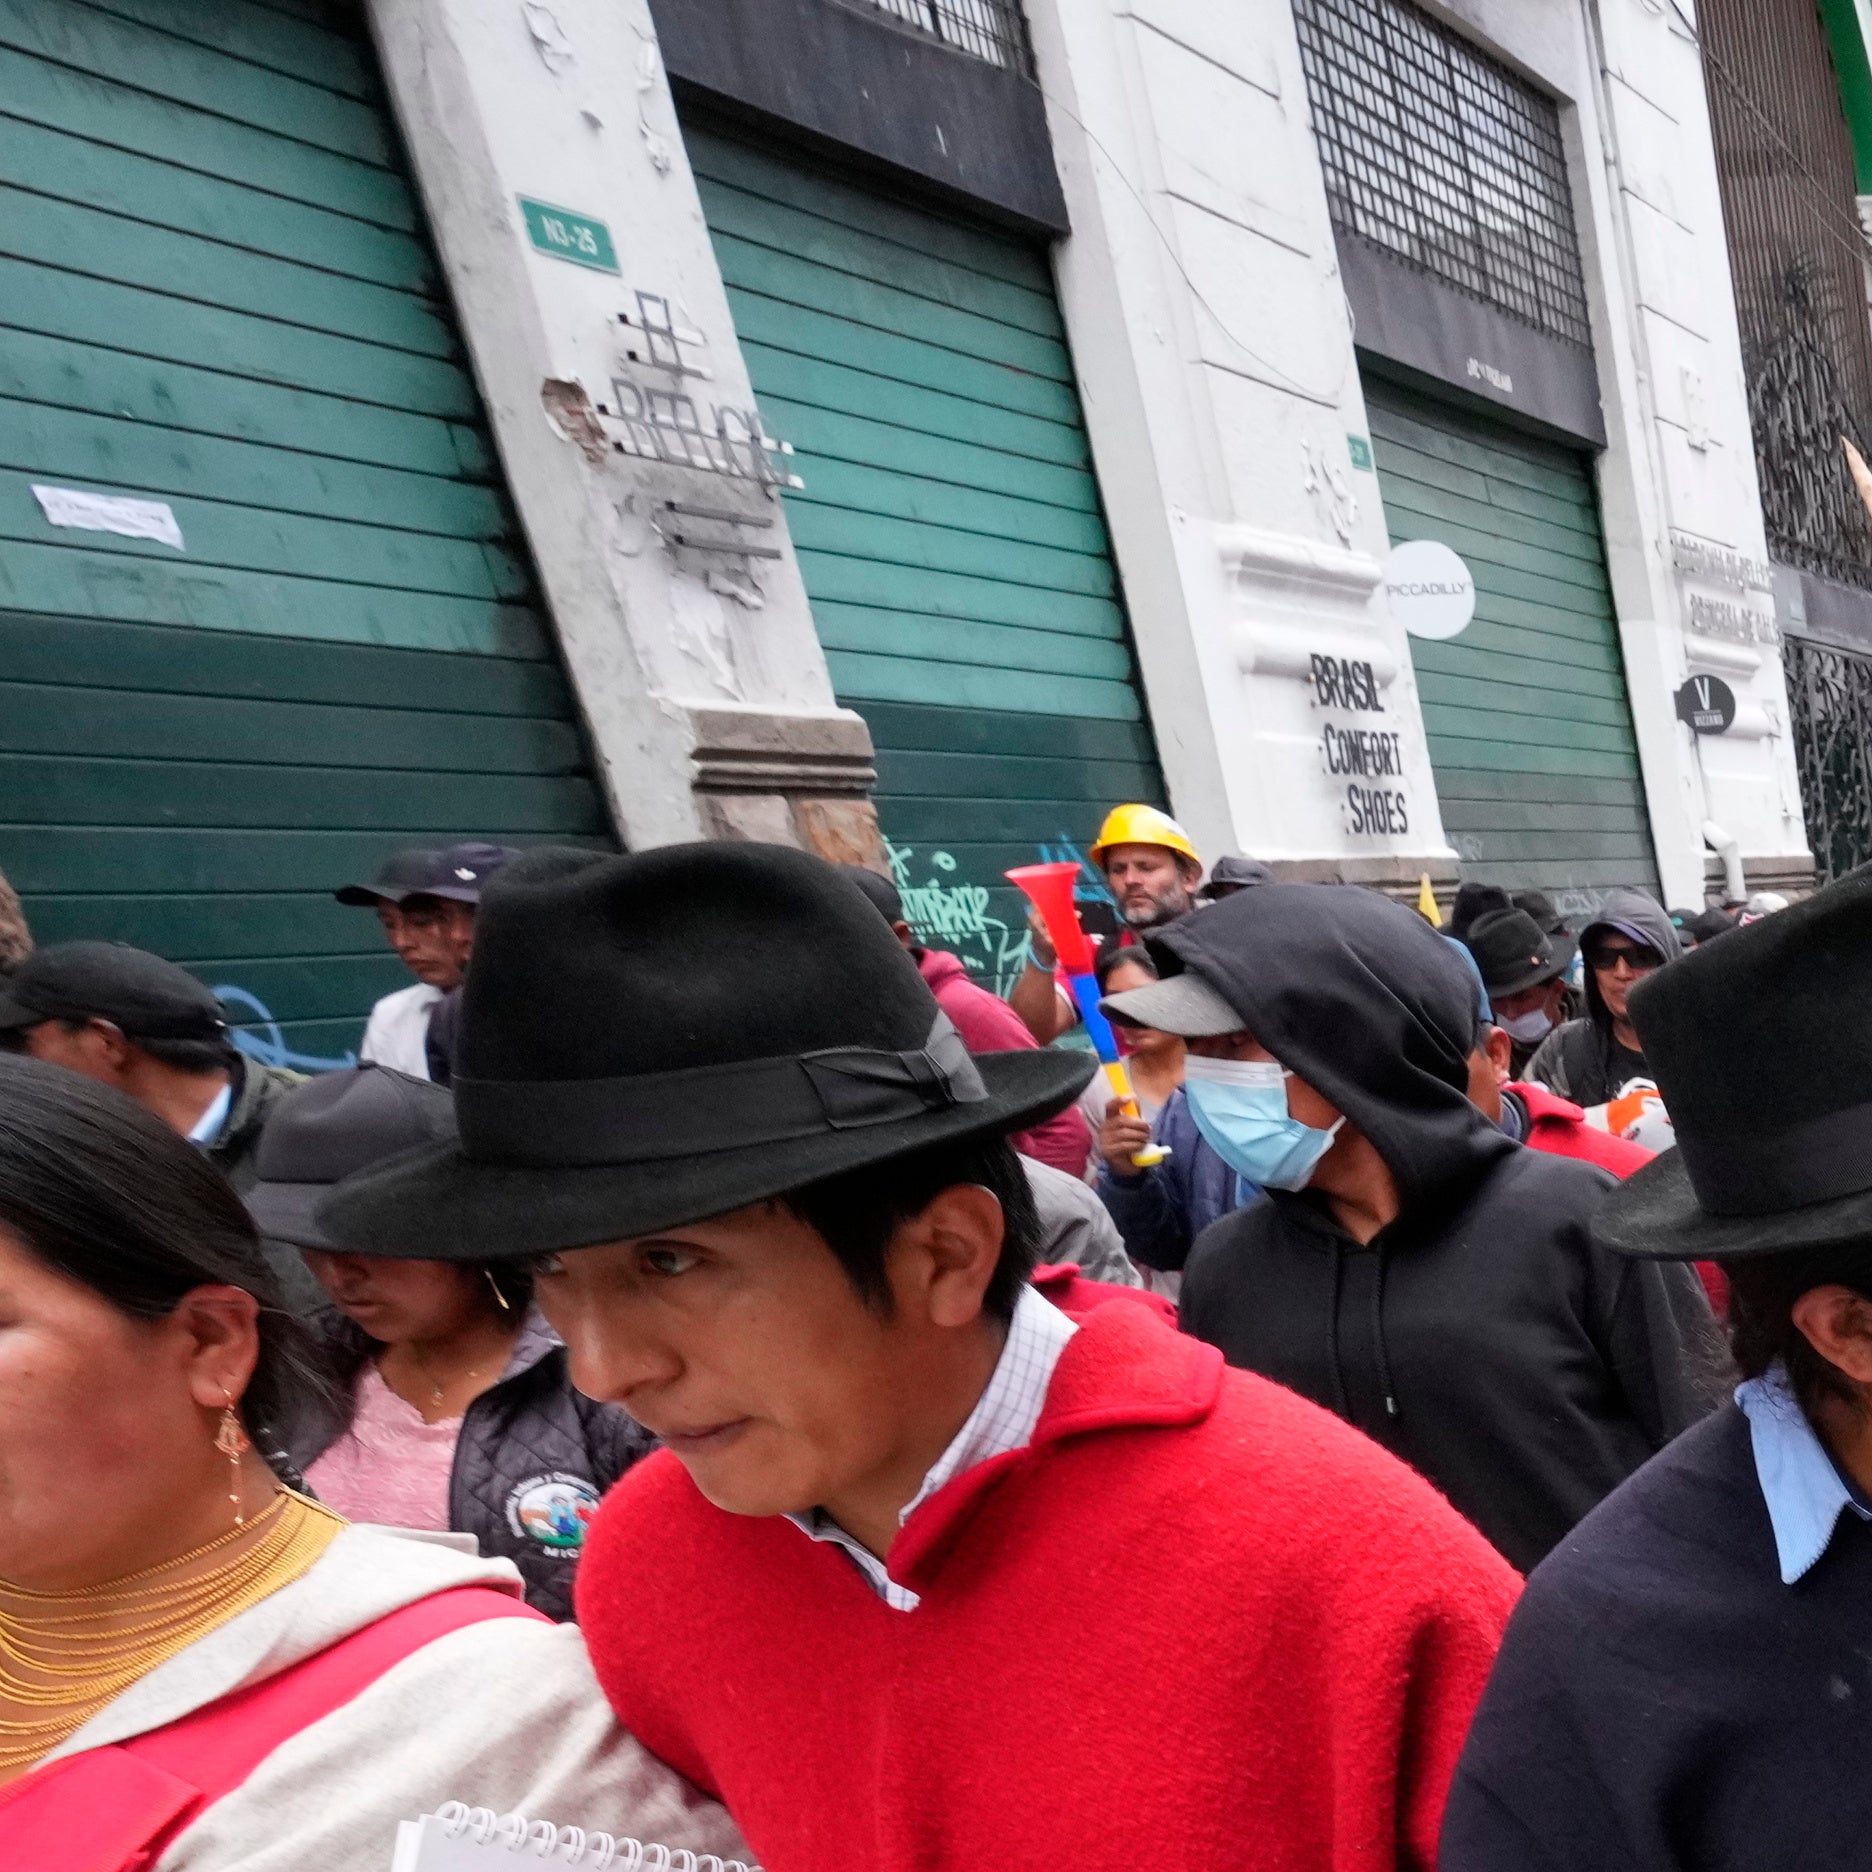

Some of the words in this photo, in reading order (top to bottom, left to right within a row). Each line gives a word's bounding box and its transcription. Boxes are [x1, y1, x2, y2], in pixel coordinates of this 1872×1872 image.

[541, 214, 597, 256] N3-25
[635, 289, 706, 377] EL
[1386, 580, 1468, 598] PICCADILLY
[1310, 652, 1385, 712] BRASIL
[1695, 678, 1710, 711] V
[1346, 783, 1409, 835] SHOES
